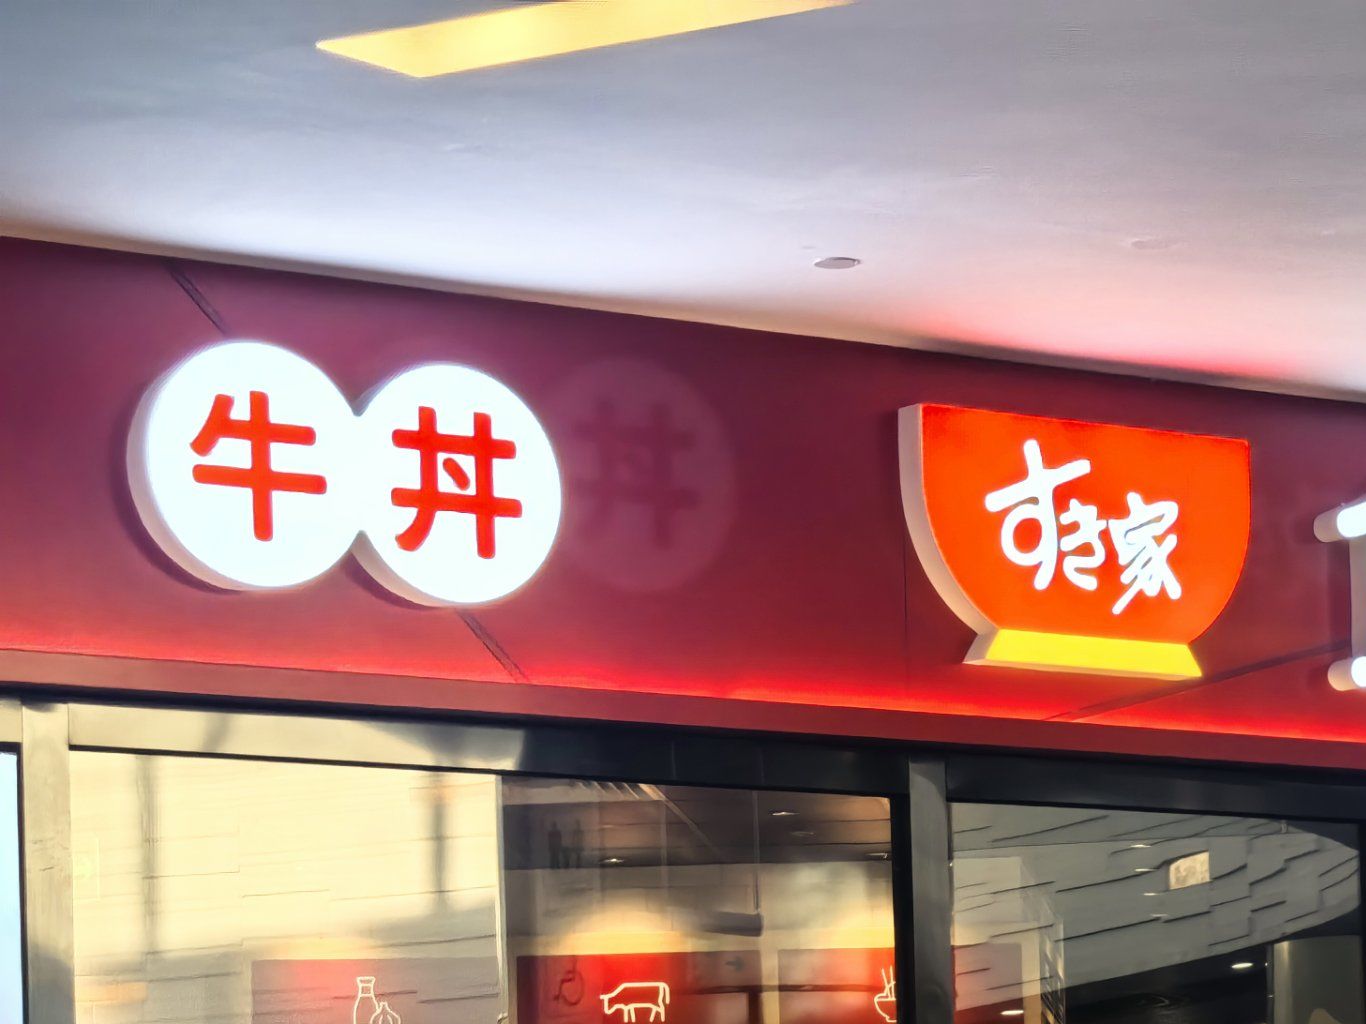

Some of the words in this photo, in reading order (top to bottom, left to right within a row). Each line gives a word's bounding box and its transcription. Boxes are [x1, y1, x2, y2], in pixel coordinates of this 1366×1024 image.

[190, 390, 523, 559] 牛丼
[985, 438, 1181, 614] すき家
